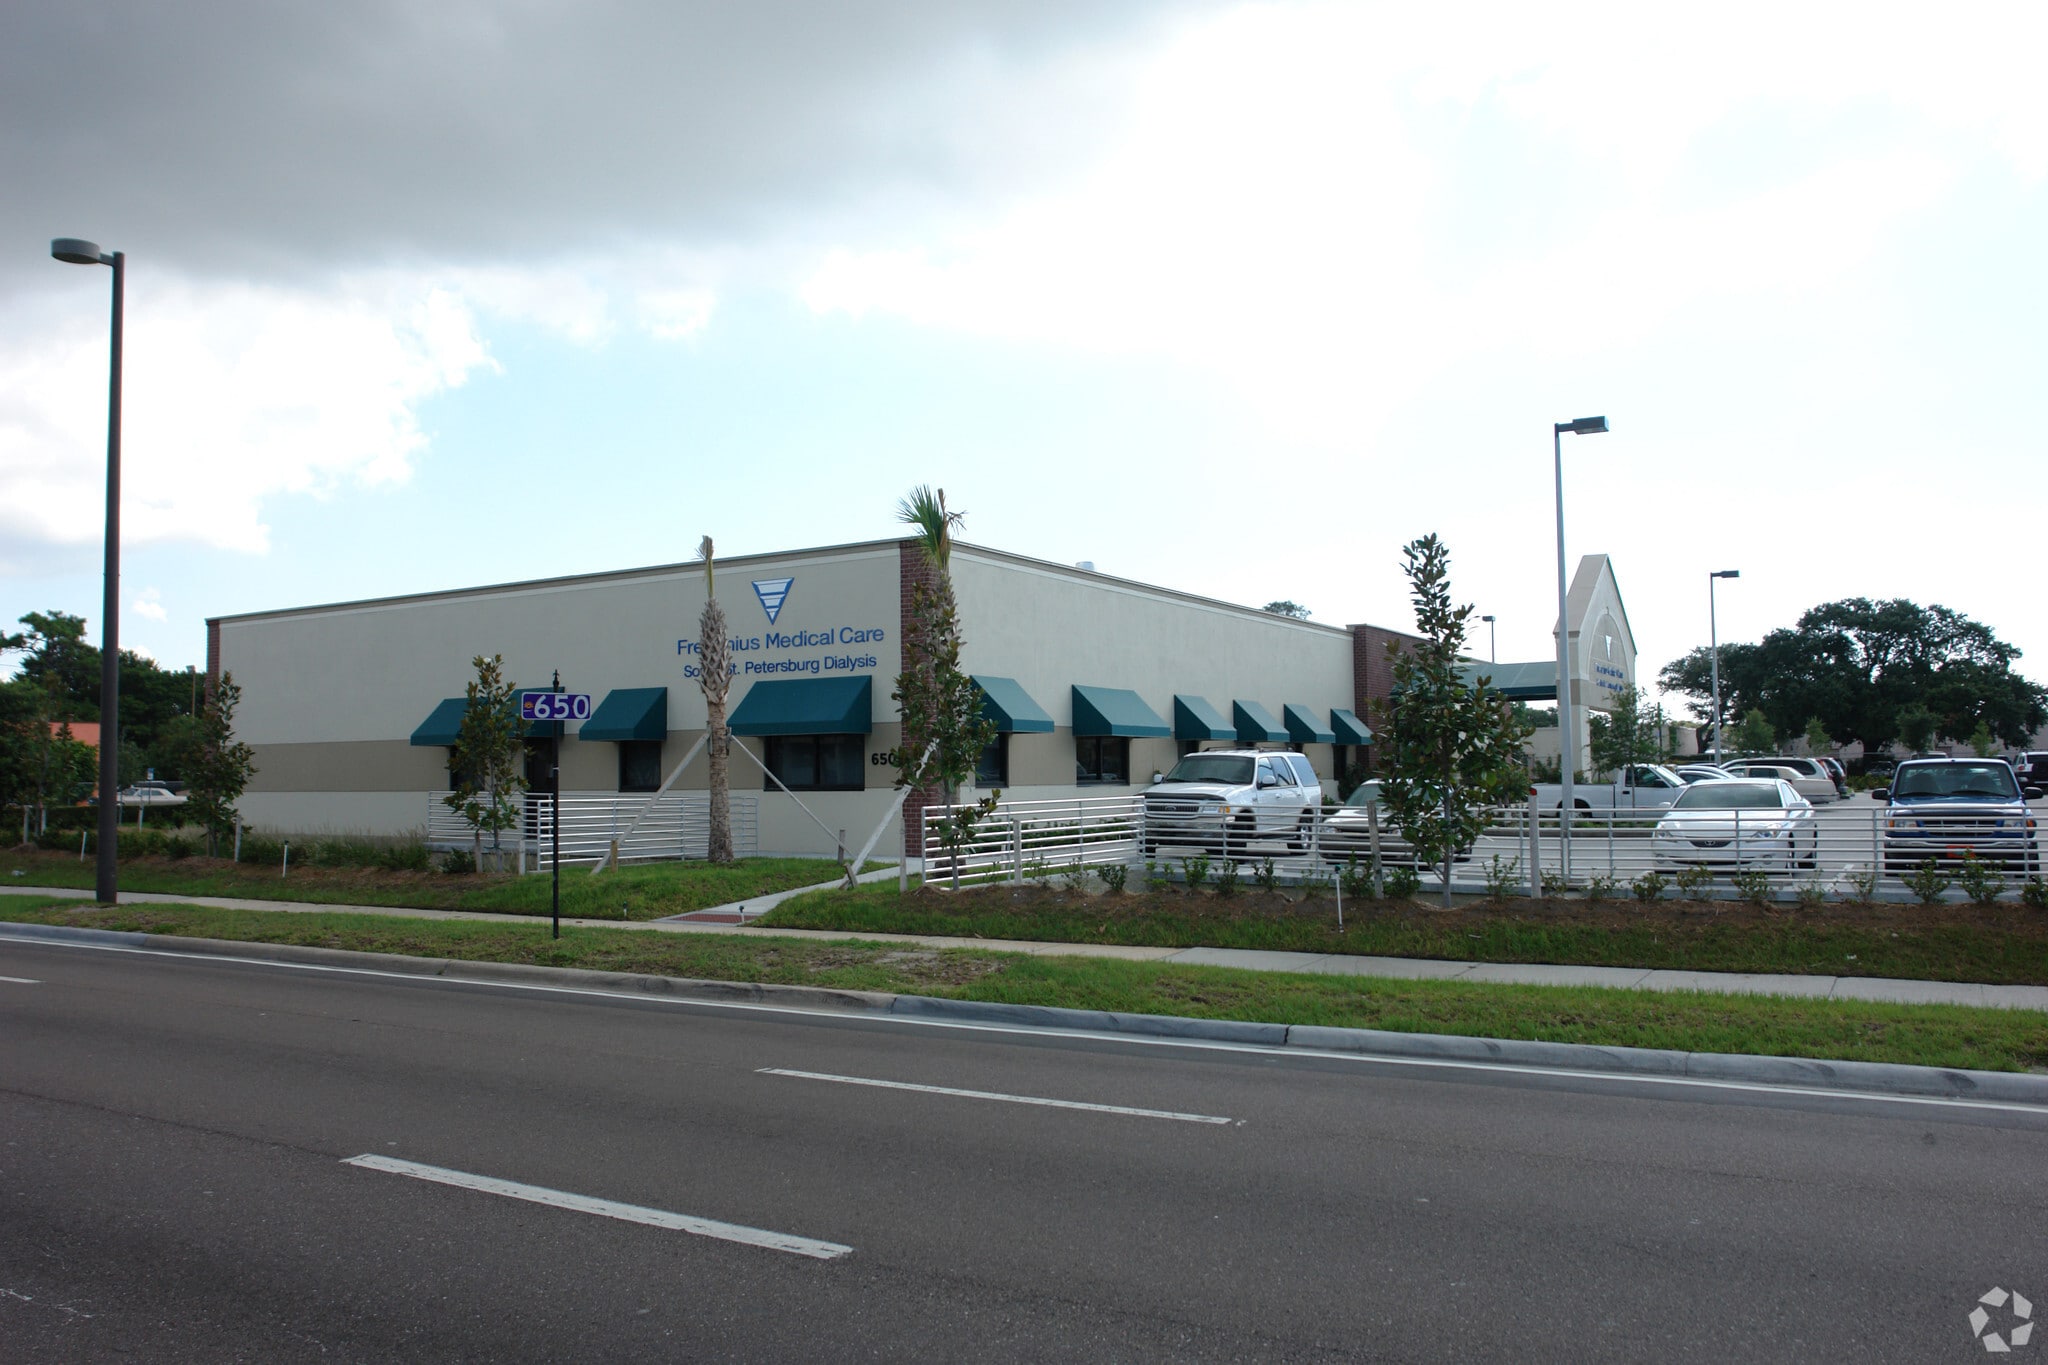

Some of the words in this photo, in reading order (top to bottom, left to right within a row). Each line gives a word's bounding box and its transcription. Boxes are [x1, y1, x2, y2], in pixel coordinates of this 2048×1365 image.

[677, 635, 760, 655] Frenius
[765, 628, 834, 649] Medical
[839, 627, 884, 644] Care
[745, 658, 820, 674] Petersburg
[824, 653, 877, 672] Dialysis
[534, 694, 589, 719] 650
